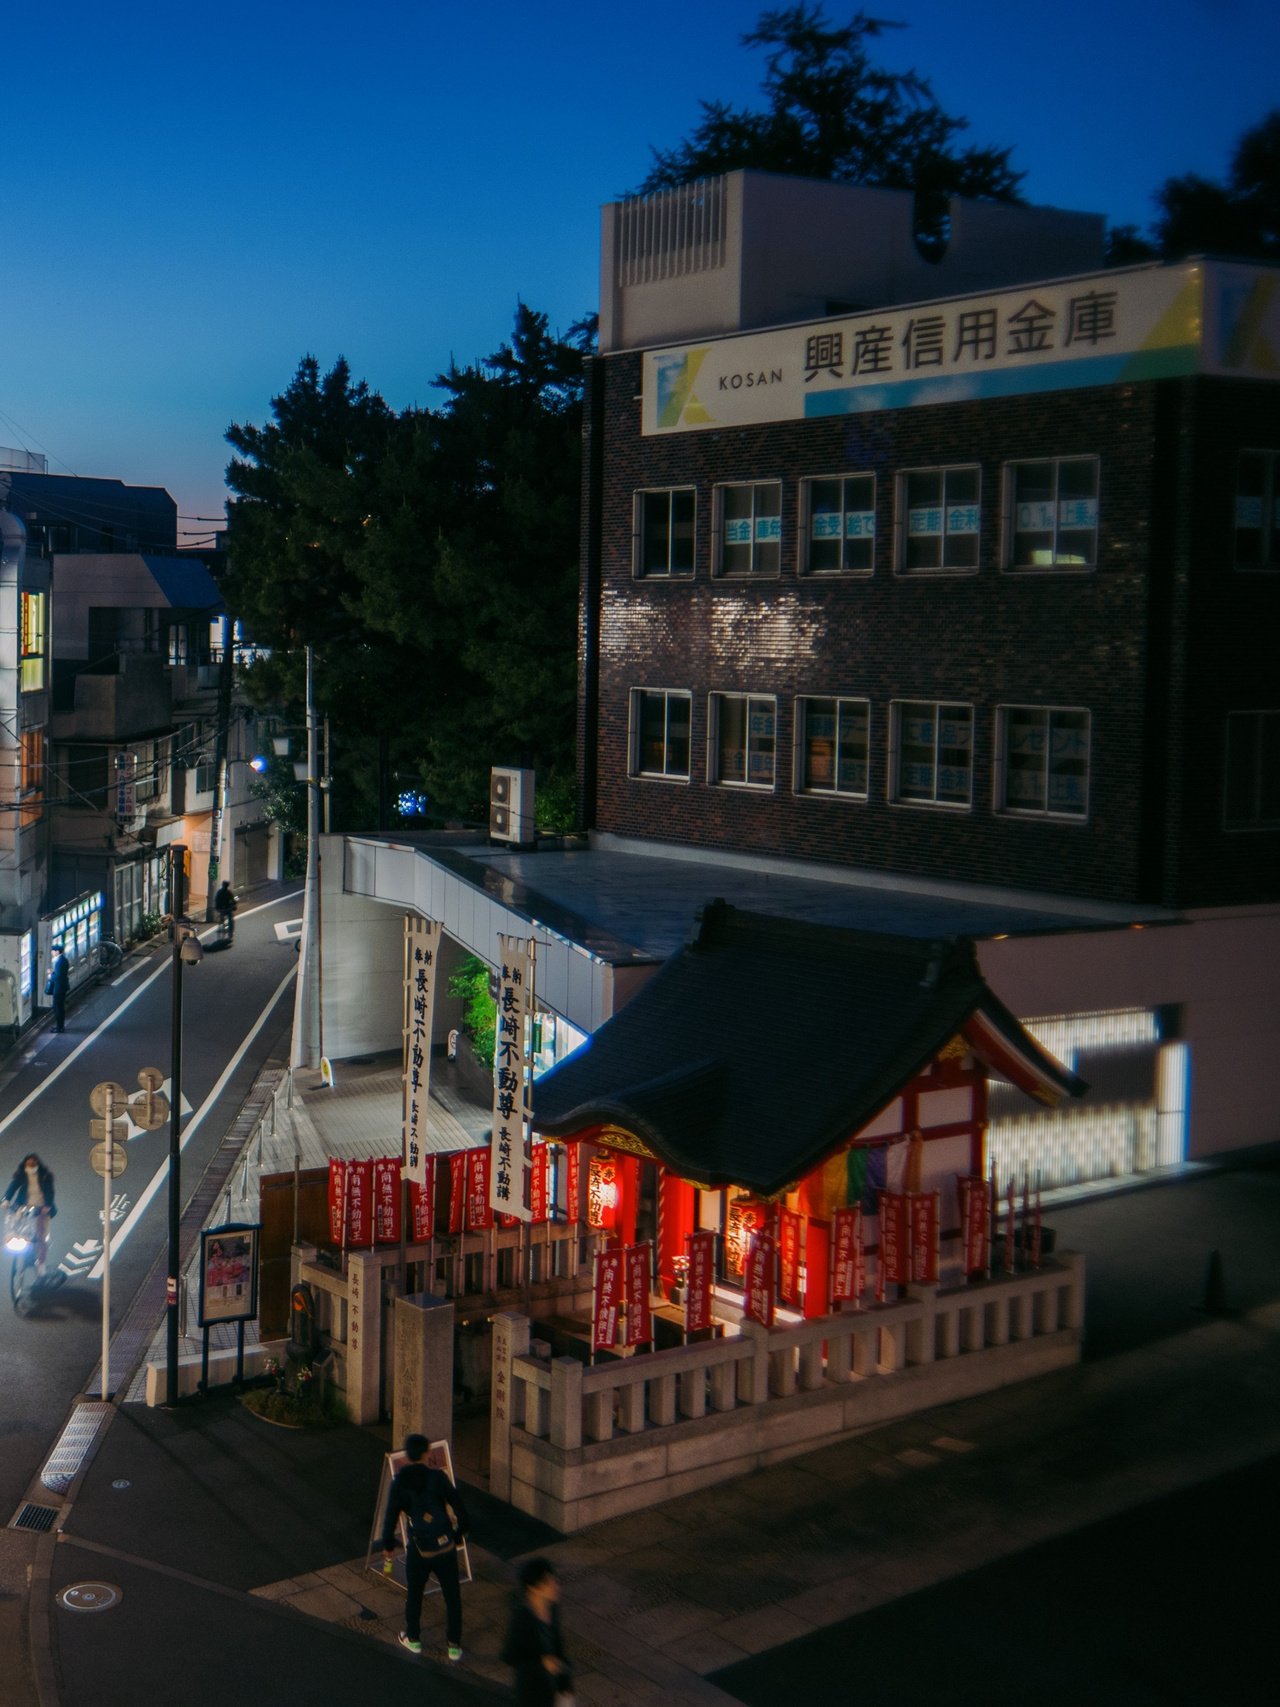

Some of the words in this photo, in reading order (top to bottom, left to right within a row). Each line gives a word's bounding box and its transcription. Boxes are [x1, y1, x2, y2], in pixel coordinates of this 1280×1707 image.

[804, 289, 1119, 383] 興産信用金庫
[719, 369, 783, 391] KOSAN
[411, 968, 428, 1094] 長崎不動尊
[496, 987, 520, 1120] 長崎不動尊
[351, 1174, 363, 1241] 南無不動明王
[381, 1172, 395, 1238] 南無不動明王
[473, 1161, 486, 1226] 南無不動明王
[632, 1264, 643, 1340] 南無不動明王
[495, 1370, 506, 1421] 金剛院
